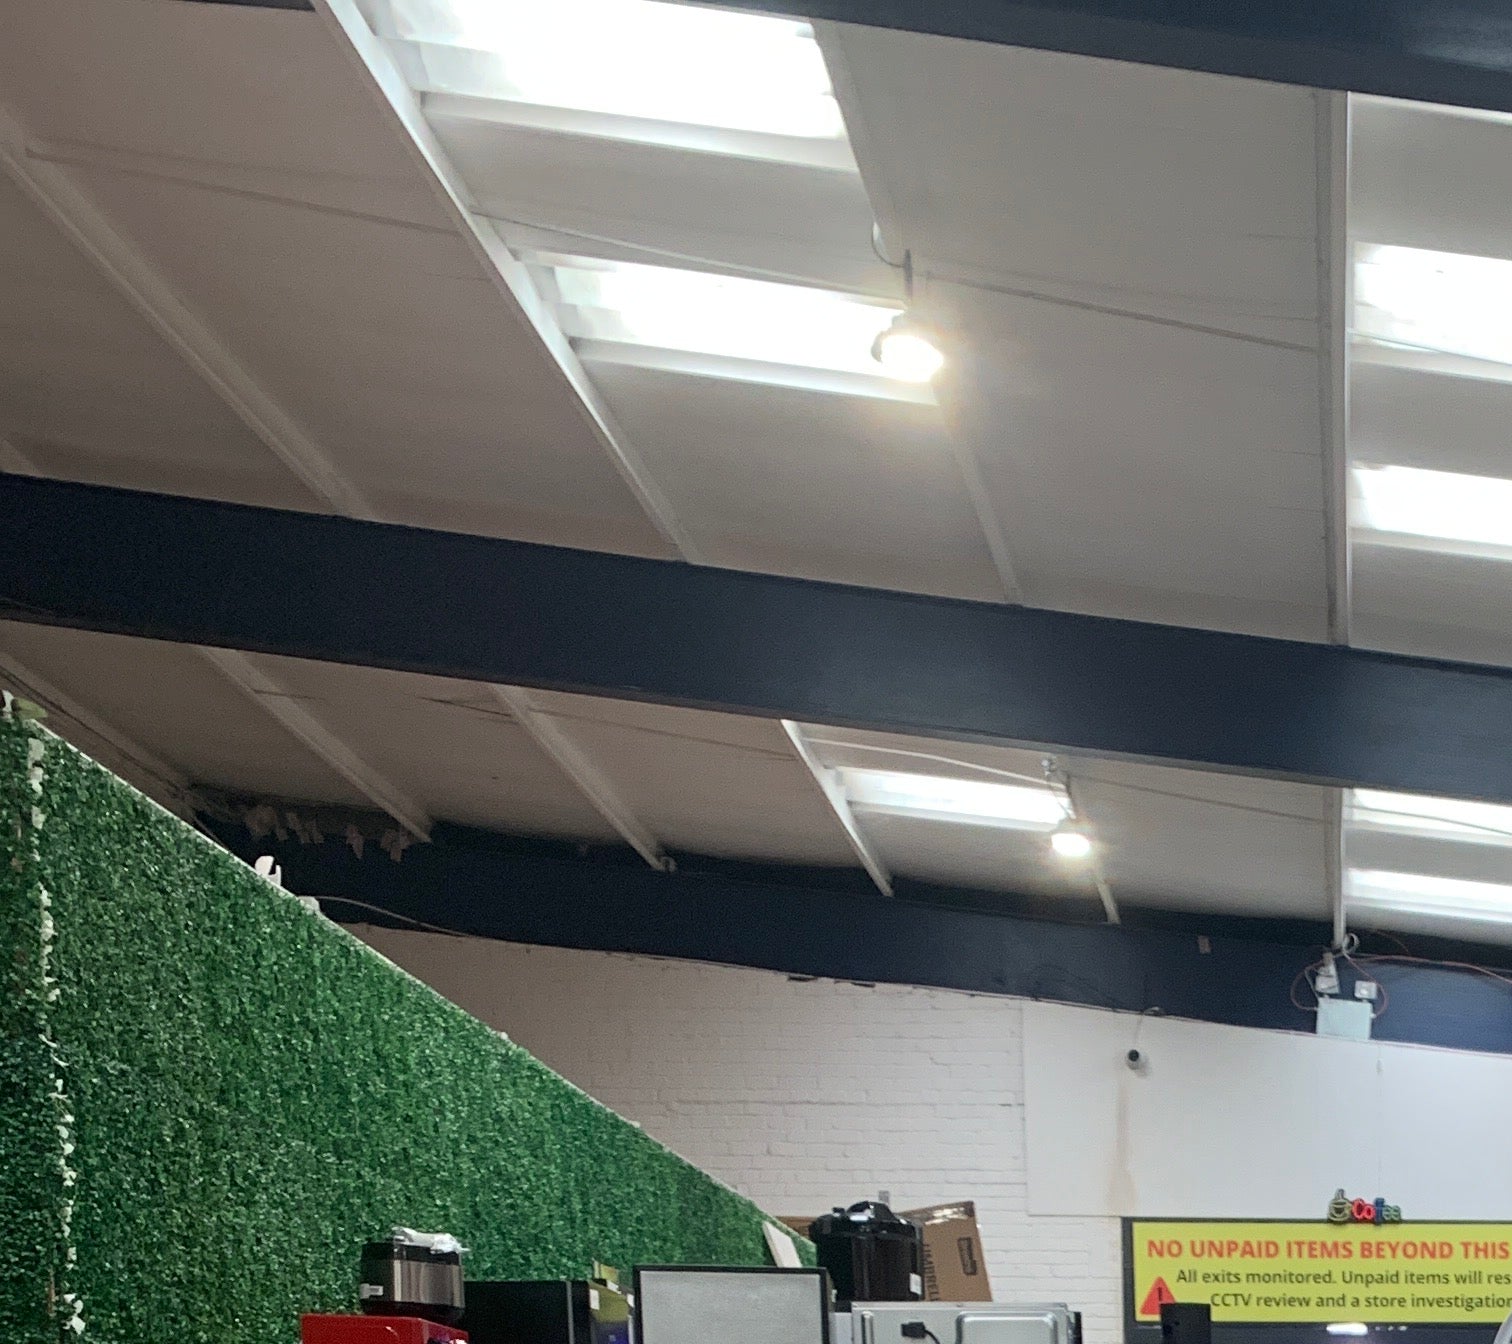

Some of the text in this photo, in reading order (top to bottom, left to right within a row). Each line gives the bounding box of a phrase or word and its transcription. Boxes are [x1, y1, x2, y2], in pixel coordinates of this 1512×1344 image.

[1147, 1240, 1183, 1259] NO
[1190, 1240, 1280, 1259] UNPAID
[1286, 1241, 1353, 1259] ITEMS
[1360, 1241, 1453, 1259] BEYOND
[1460, 1242, 1510, 1260] THIS
[1176, 1269, 1197, 1284] All
[1202, 1269, 1241, 1284] exits
[1246, 1269, 1337, 1284] monitored.
[1342, 1270, 1400, 1287] Unpaid
[1404, 1270, 1450, 1285] items
[1454, 1270, 1482, 1285] will
[1210, 1293, 1252, 1307] CCTV
[1256, 1294, 1309, 1308] review
[1315, 1293, 1346, 1308] and
[1351, 1297, 1360, 1308] a
[1366, 1295, 1406, 1308] store
